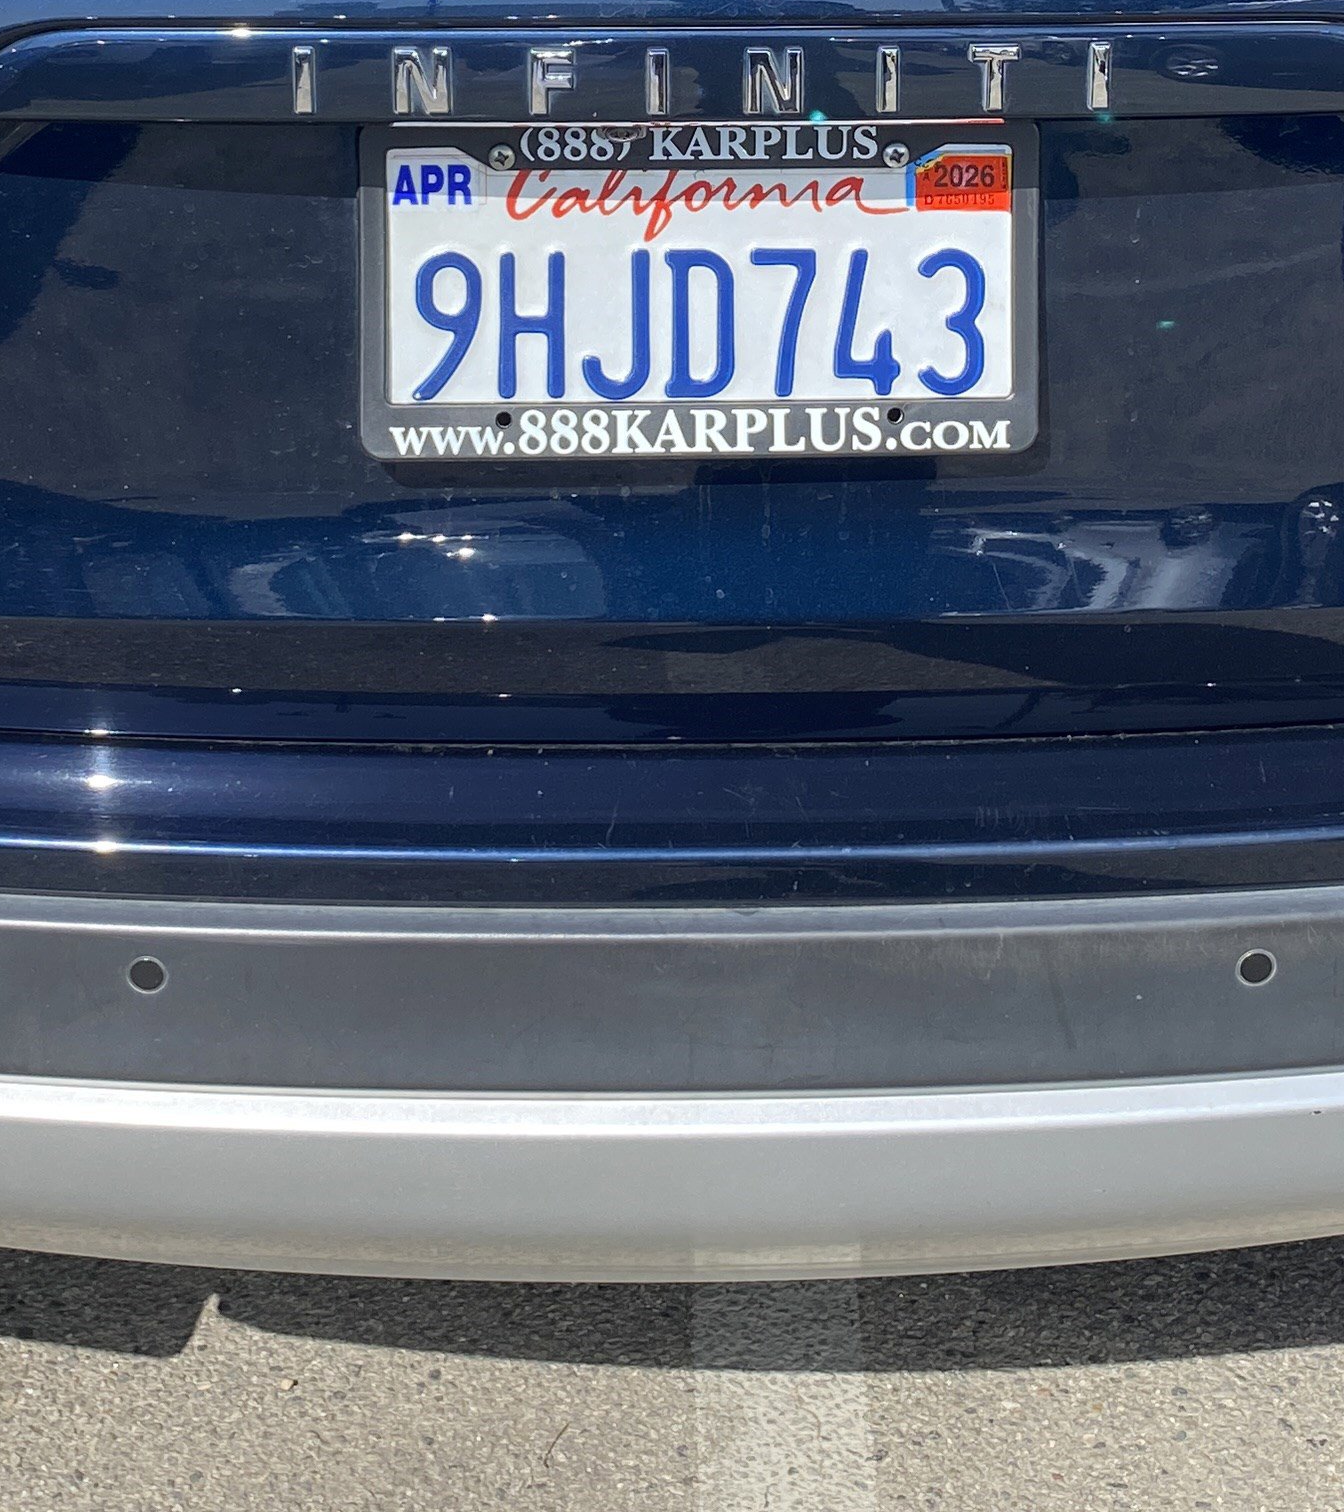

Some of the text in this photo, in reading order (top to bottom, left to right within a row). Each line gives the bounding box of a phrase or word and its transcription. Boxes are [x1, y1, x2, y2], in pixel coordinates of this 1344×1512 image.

[292, 42, 1113, 116] INFINITI
[648, 125, 878, 160] KARPLUS
[392, 164, 472, 206] APR
[934, 162, 995, 188] 2026
[505, 169, 910, 242] California
[413, 248, 987, 401] 9HJD743
